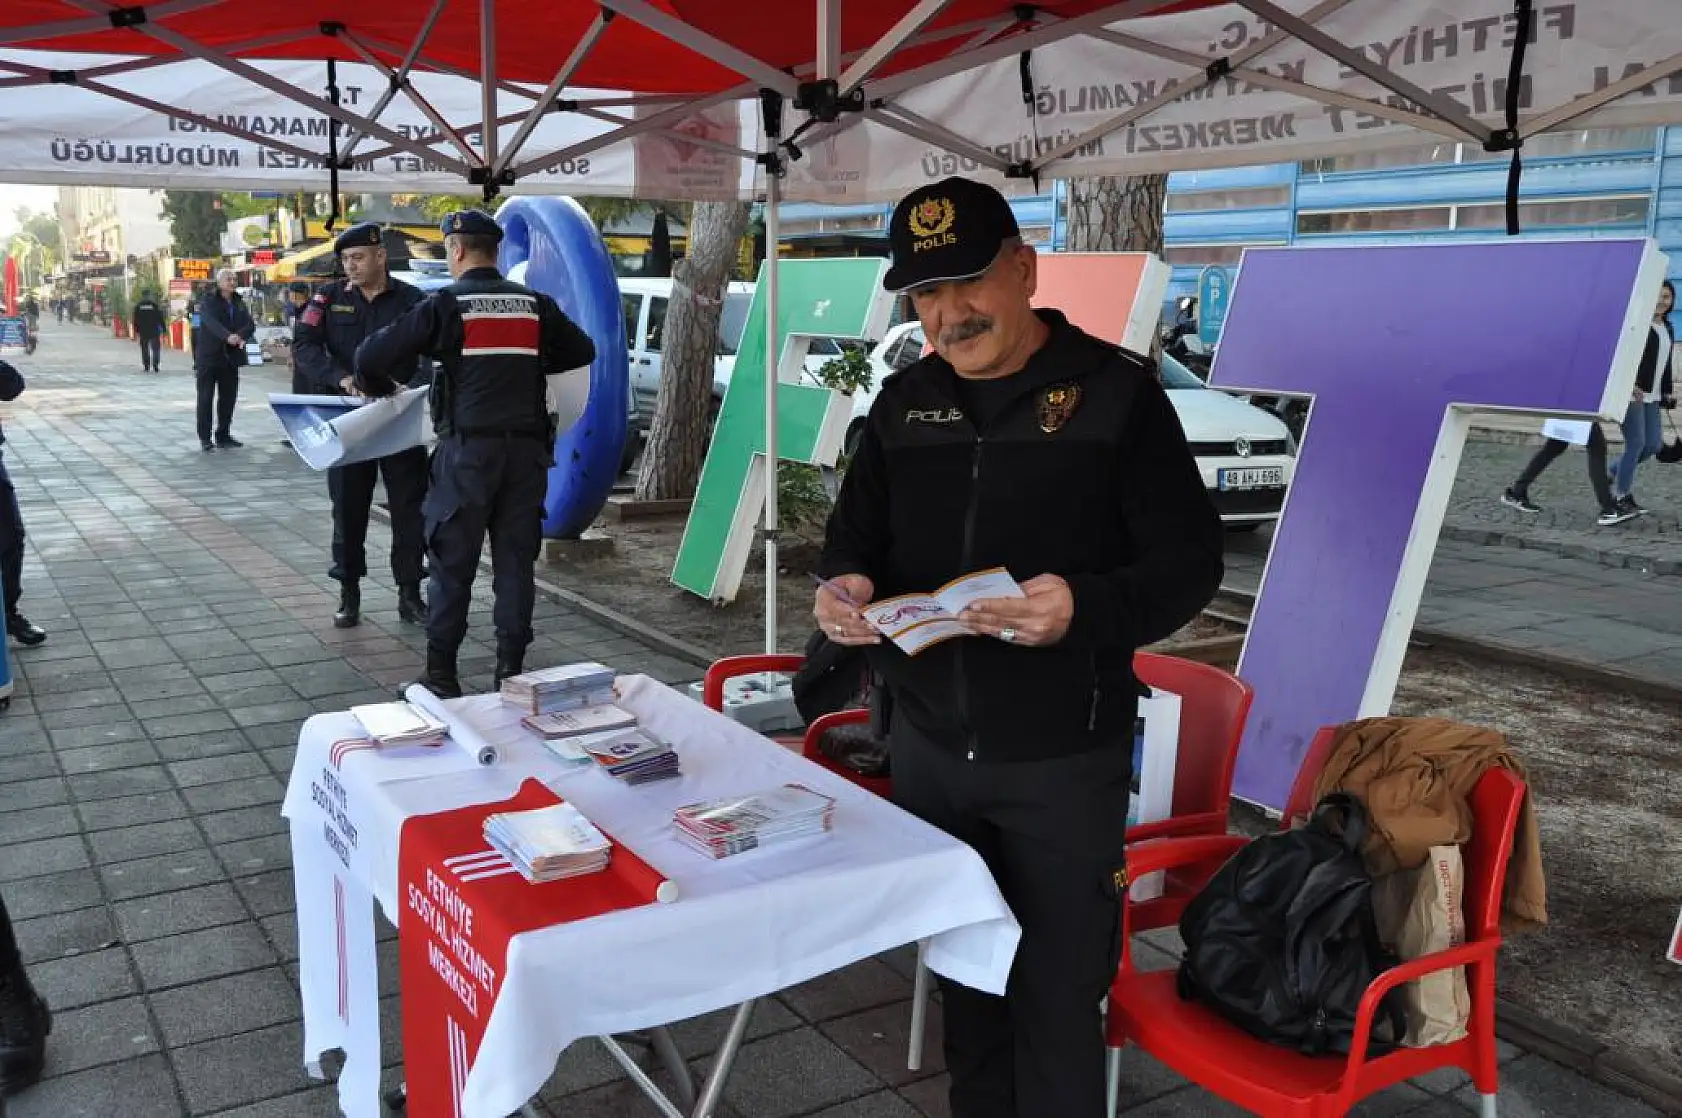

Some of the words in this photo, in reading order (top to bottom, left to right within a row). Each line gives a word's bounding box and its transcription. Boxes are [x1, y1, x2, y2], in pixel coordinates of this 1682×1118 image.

[468, 299, 532, 313] JANDARMA
[408, 882, 450, 947] SOSYAL
[451, 925, 497, 999] HİZMET
[427, 867, 473, 938] FETHİYE
[428, 938, 479, 1020] MERKEZİ
